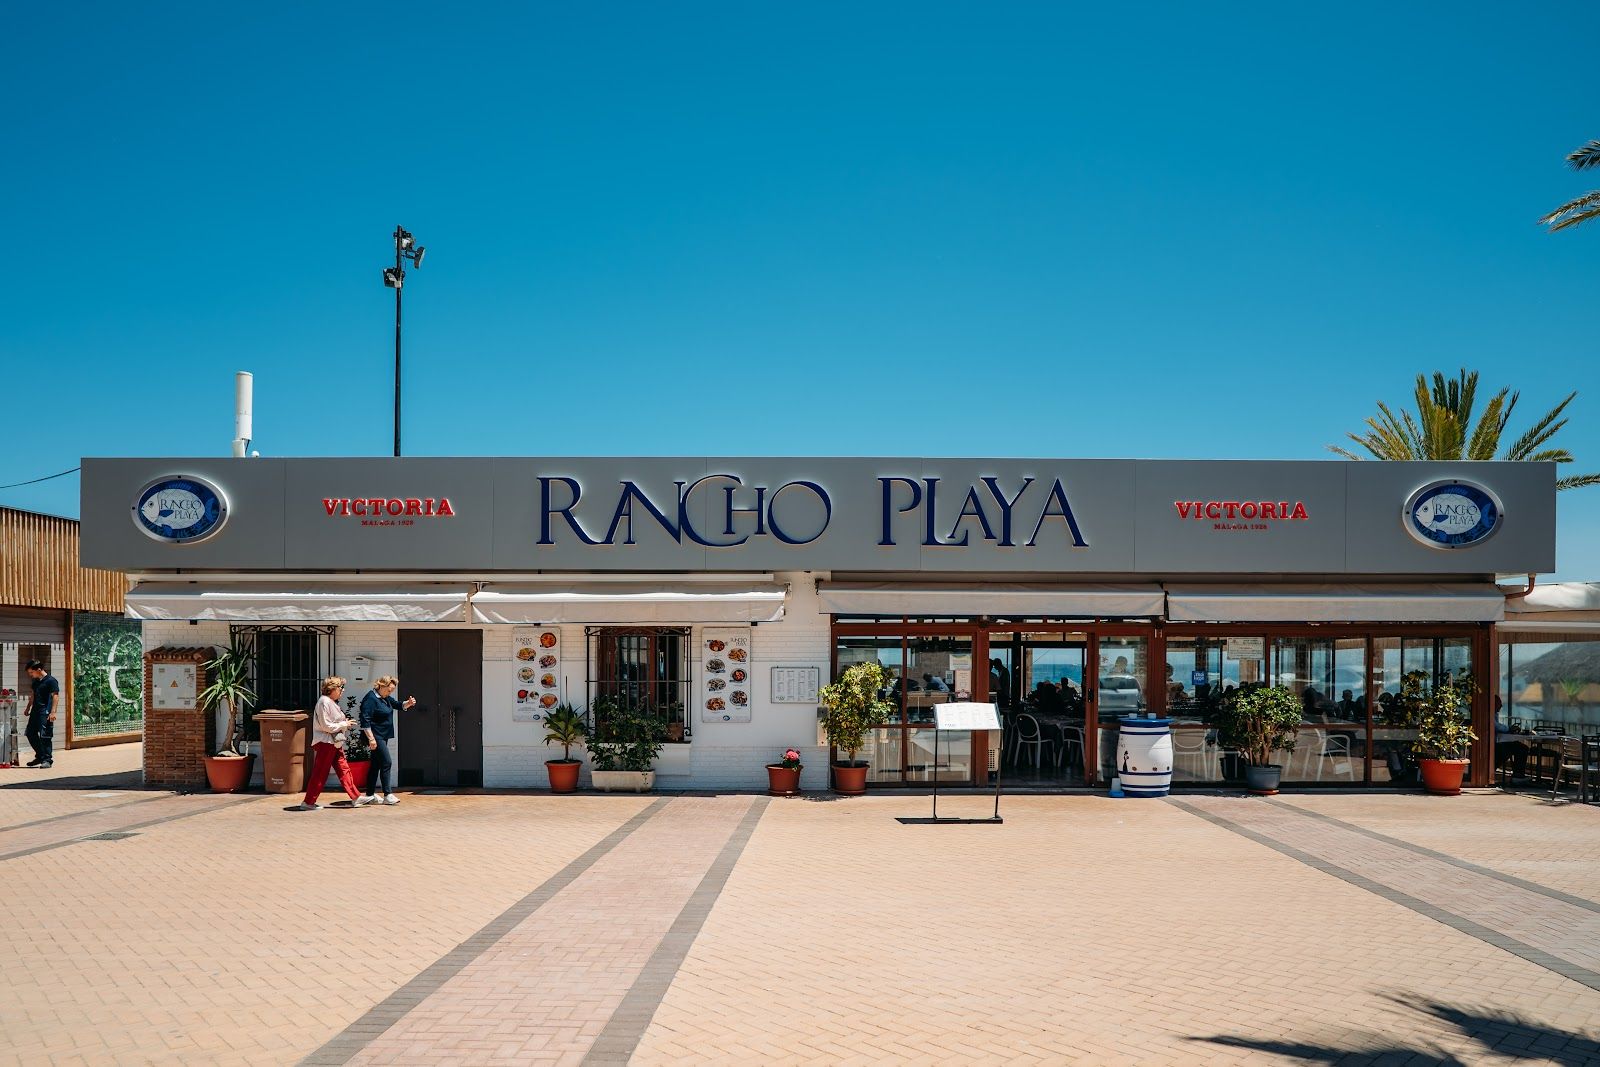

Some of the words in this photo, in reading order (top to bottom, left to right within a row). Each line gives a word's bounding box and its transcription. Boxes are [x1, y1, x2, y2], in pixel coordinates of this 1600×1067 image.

[160, 498, 202, 510] RANCHO
[322, 498, 455, 516] VICTORIA
[1174, 501, 1309, 519] VICTORIA
[1435, 503, 1478, 515] RANCHO
[174, 509, 199, 520] PLAYA
[536, 474, 832, 547] RANCHO
[877, 477, 1089, 547] PLAYA
[1449, 515, 1475, 525] PLAYA
